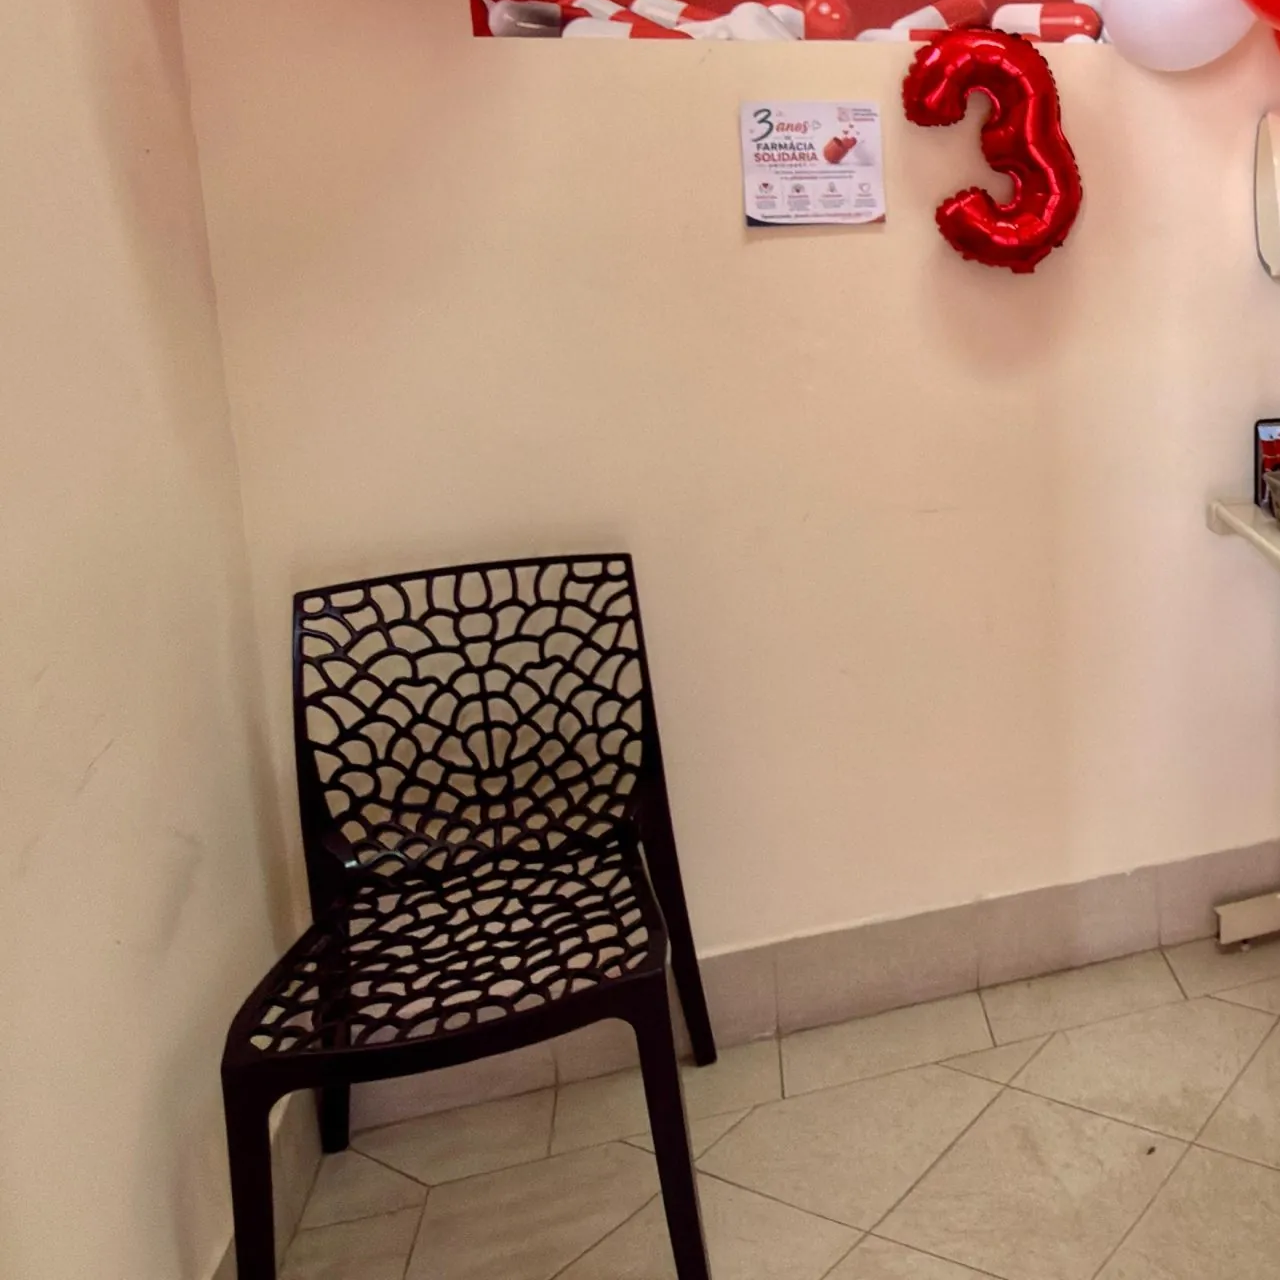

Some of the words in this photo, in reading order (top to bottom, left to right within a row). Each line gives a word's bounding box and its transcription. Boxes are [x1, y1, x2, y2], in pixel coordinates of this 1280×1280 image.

[751, 108, 774, 142] 3
[775, 120, 809, 134] anos
[756, 140, 815, 151] FARMÁCIA
